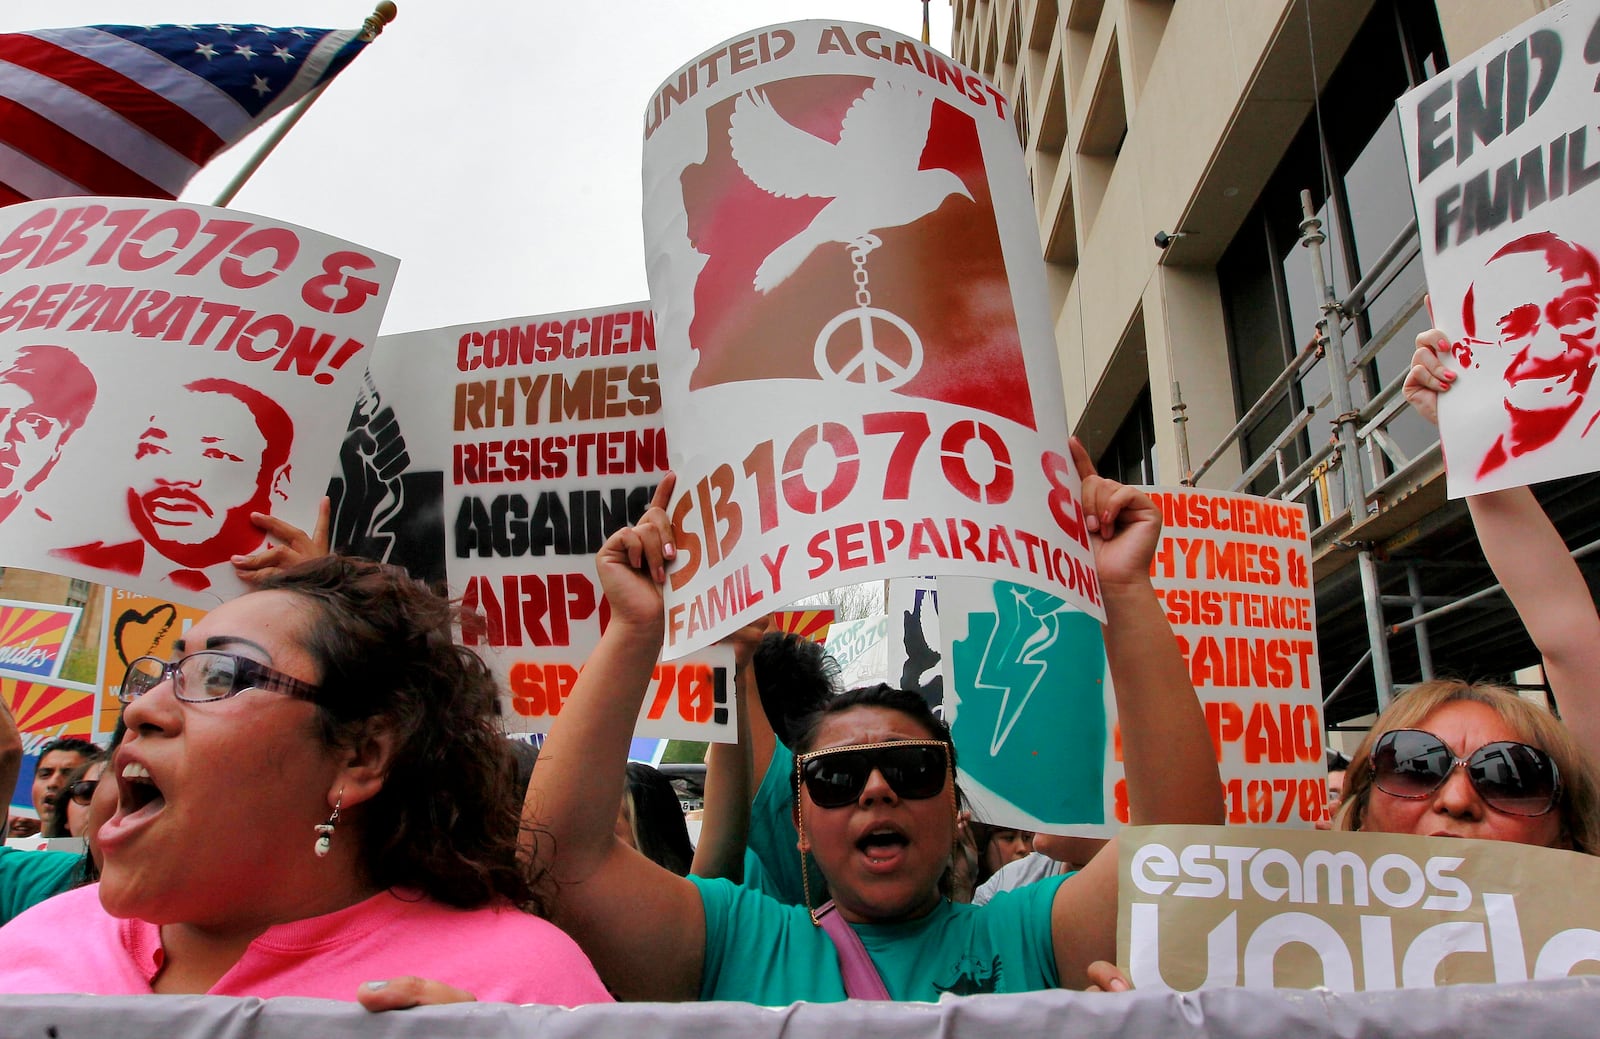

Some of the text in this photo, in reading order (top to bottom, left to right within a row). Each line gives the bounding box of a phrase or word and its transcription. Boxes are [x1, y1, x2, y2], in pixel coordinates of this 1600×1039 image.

[645, 26, 1008, 141] UNITED AGAINST
[1417, 28, 1562, 184] END
[0, 205, 380, 314] SB1070 &
[0, 282, 364, 385] SEPARATION!
[453, 363, 662, 431] RHYMES
[669, 411, 1090, 592] SB1070 &
[461, 573, 611, 647] ARP
[669, 517, 1102, 647] FAMILY SEPARATION!
[1155, 589, 1312, 632] SISTENCE
[1287, 547, 1309, 589] &
